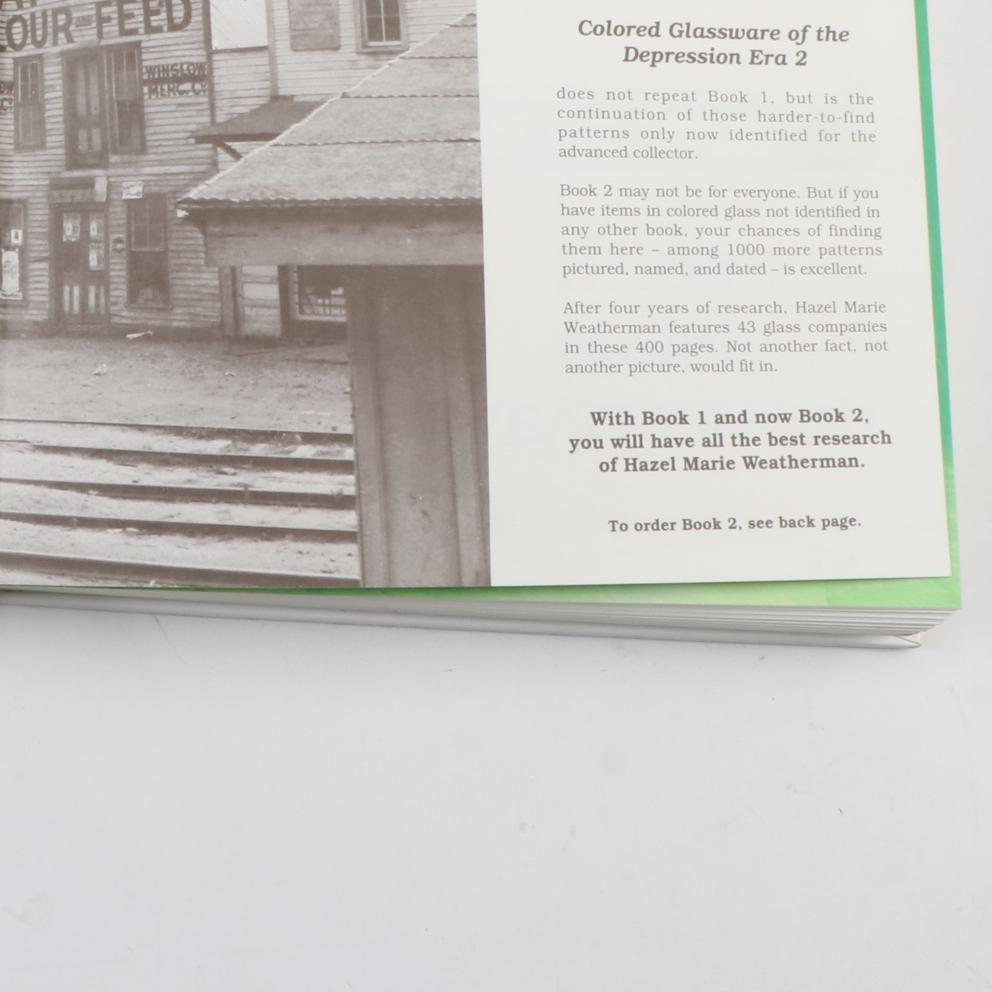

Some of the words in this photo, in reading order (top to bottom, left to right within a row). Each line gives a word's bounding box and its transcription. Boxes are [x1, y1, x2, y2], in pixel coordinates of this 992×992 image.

[577, 19, 661, 38] Colored
[668, 21, 781, 41] Glassware
[787, 24, 812, 46] of
[815, 25, 850, 42] the
[622, 45, 742, 68] Depression
[748, 49, 788, 66] Era
[794, 49, 808, 66] 2
[144, 61, 208, 80] WINSLOW
[556, 107, 666, 121] continuation
[676, 107, 691, 121] of
[702, 108, 747, 122] those
[756, 109, 875, 124] harder-to-find
[560, 202, 595, 216] have
[600, 204, 641, 217] items
[646, 204, 661, 217] in
[665, 203, 718, 217] colored
[724, 204, 761, 221] glass
[765, 206, 789, 218] not
[794, 204, 861, 218] identified
[866, 206, 880, 218] in
[563, 320, 661, 334] Weatherman
[668, 320, 730, 334] features
[736, 320, 756, 334] 43
[762, 320, 801, 337] glass
[807, 320, 888, 336] companies
[564, 341, 580, 354] in
[587, 340, 628, 354] these
[635, 340, 664, 354] 400
[671, 342, 718, 357] pages.
[726, 339, 752, 353] Not
[759, 339, 818, 353] another
[824, 338, 856, 353] fact,
[863, 340, 888, 352] not
[589, 410, 636, 426] With
[641, 409, 690, 426] Book
[697, 410, 707, 425] 1
[714, 408, 749, 425] and
[754, 412, 793, 424] now
[797, 407, 846, 423] Book
[851, 407, 869, 424] 2,
[568, 437, 604, 454] you
[609, 433, 644, 449] will
[649, 433, 695, 449] have
[701, 432, 724, 448] all
[729, 431, 761, 447] the
[766, 431, 807, 447] best
[812, 429, 892, 446] research
[598, 456, 619, 473] of
[623, 455, 677, 472] Hazel
[682, 455, 736, 471] Marie
[741, 454, 865, 470] Weatherman.
[607, 519, 629, 532] To
[633, 518, 677, 532] order
[681, 517, 723, 531] Book
[727, 516, 742, 531] 2,
[747, 519, 773, 529] see
[777, 514, 816, 528] back
[820, 515, 862, 531] page.
